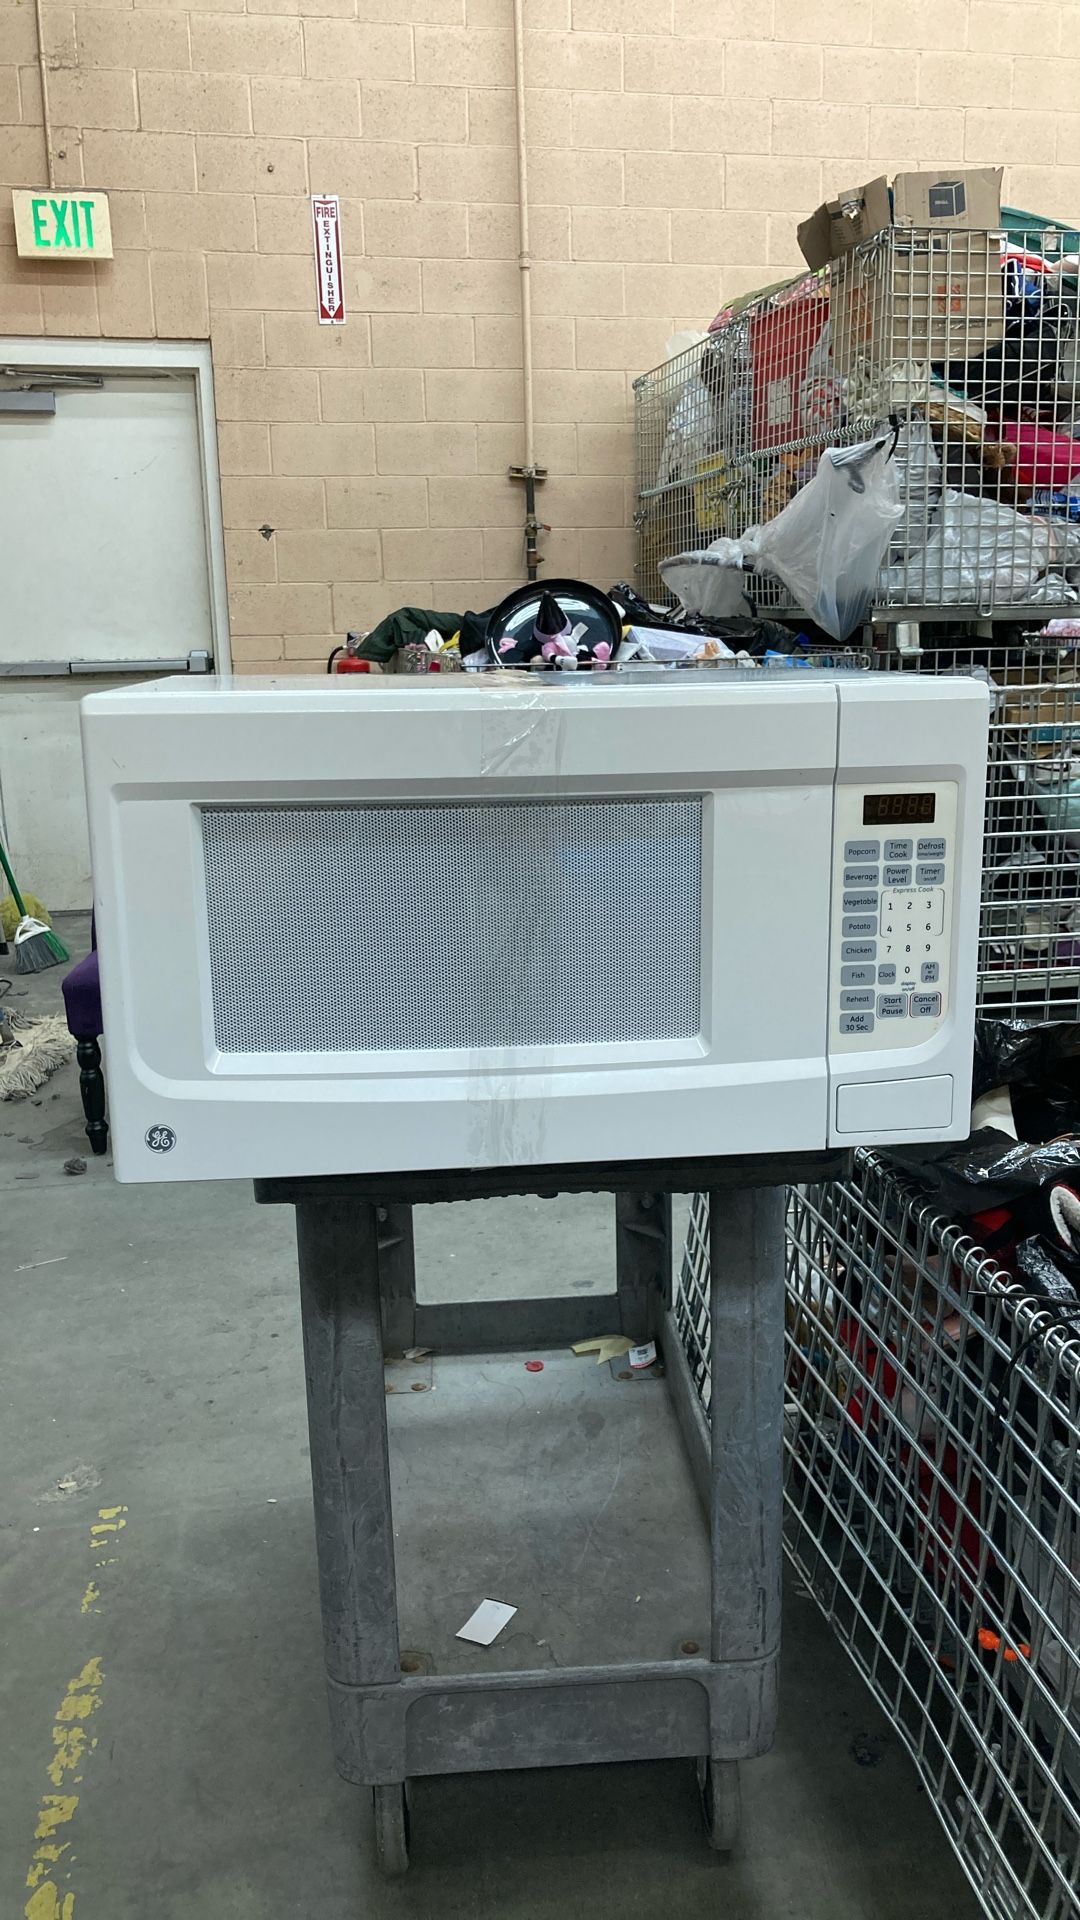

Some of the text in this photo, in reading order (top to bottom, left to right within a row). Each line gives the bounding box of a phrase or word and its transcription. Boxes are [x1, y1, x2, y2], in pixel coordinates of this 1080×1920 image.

[316, 207, 336, 219] FIRE
[31, 199, 95, 248] EXIT
[323, 220, 335, 312] EXTINGUISHER
[918, 842, 944, 850] Defrost
[848, 848, 876, 857] Popcorn
[845, 873, 878, 882] Beverage
[843, 898, 878, 907] Vegetable
